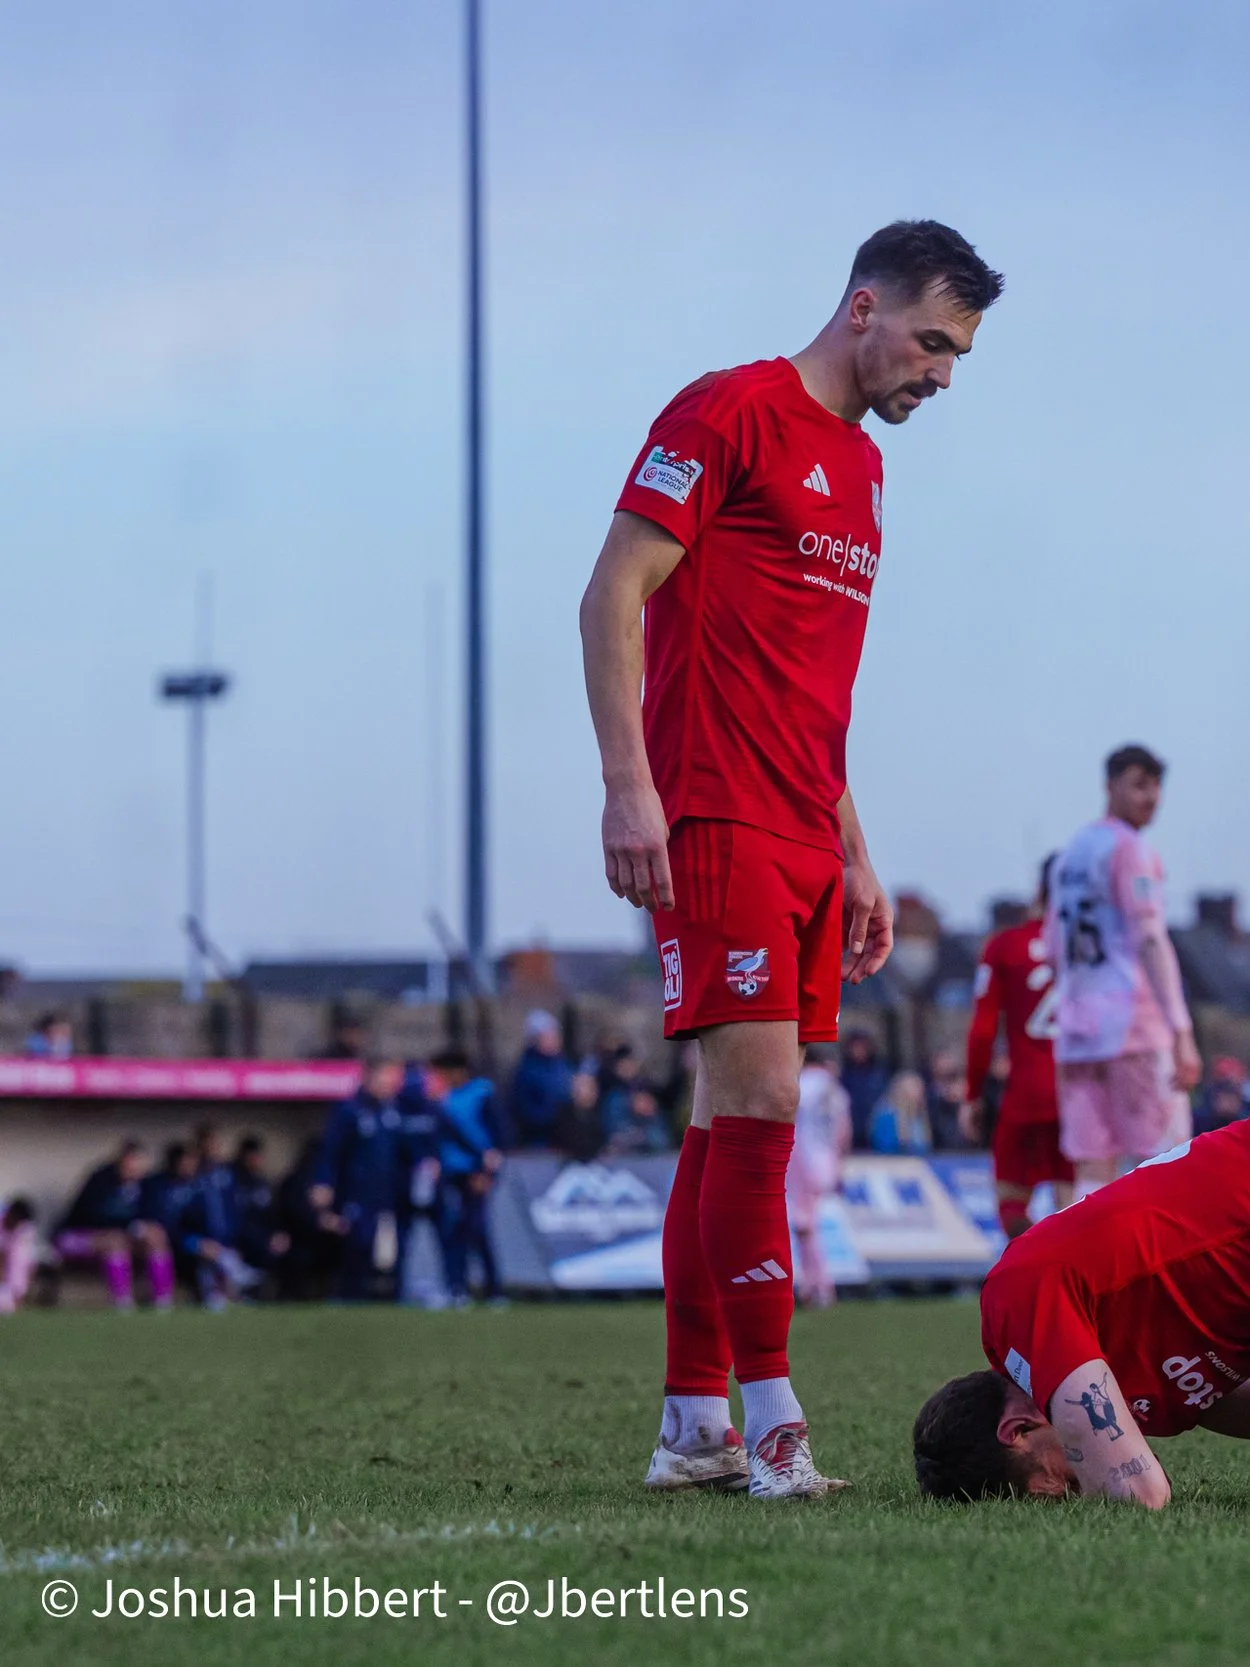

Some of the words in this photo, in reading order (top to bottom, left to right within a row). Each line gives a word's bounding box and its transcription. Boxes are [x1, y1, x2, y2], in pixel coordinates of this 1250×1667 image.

[657, 470, 688, 489] NATIONAL
[657, 477, 683, 492] LEAGUE
[803, 573, 833, 592] working
[845, 586, 870, 607] WILSON
[1204, 1350, 1240, 1382] WILSONS
[1161, 1355, 1224, 1410] stop
